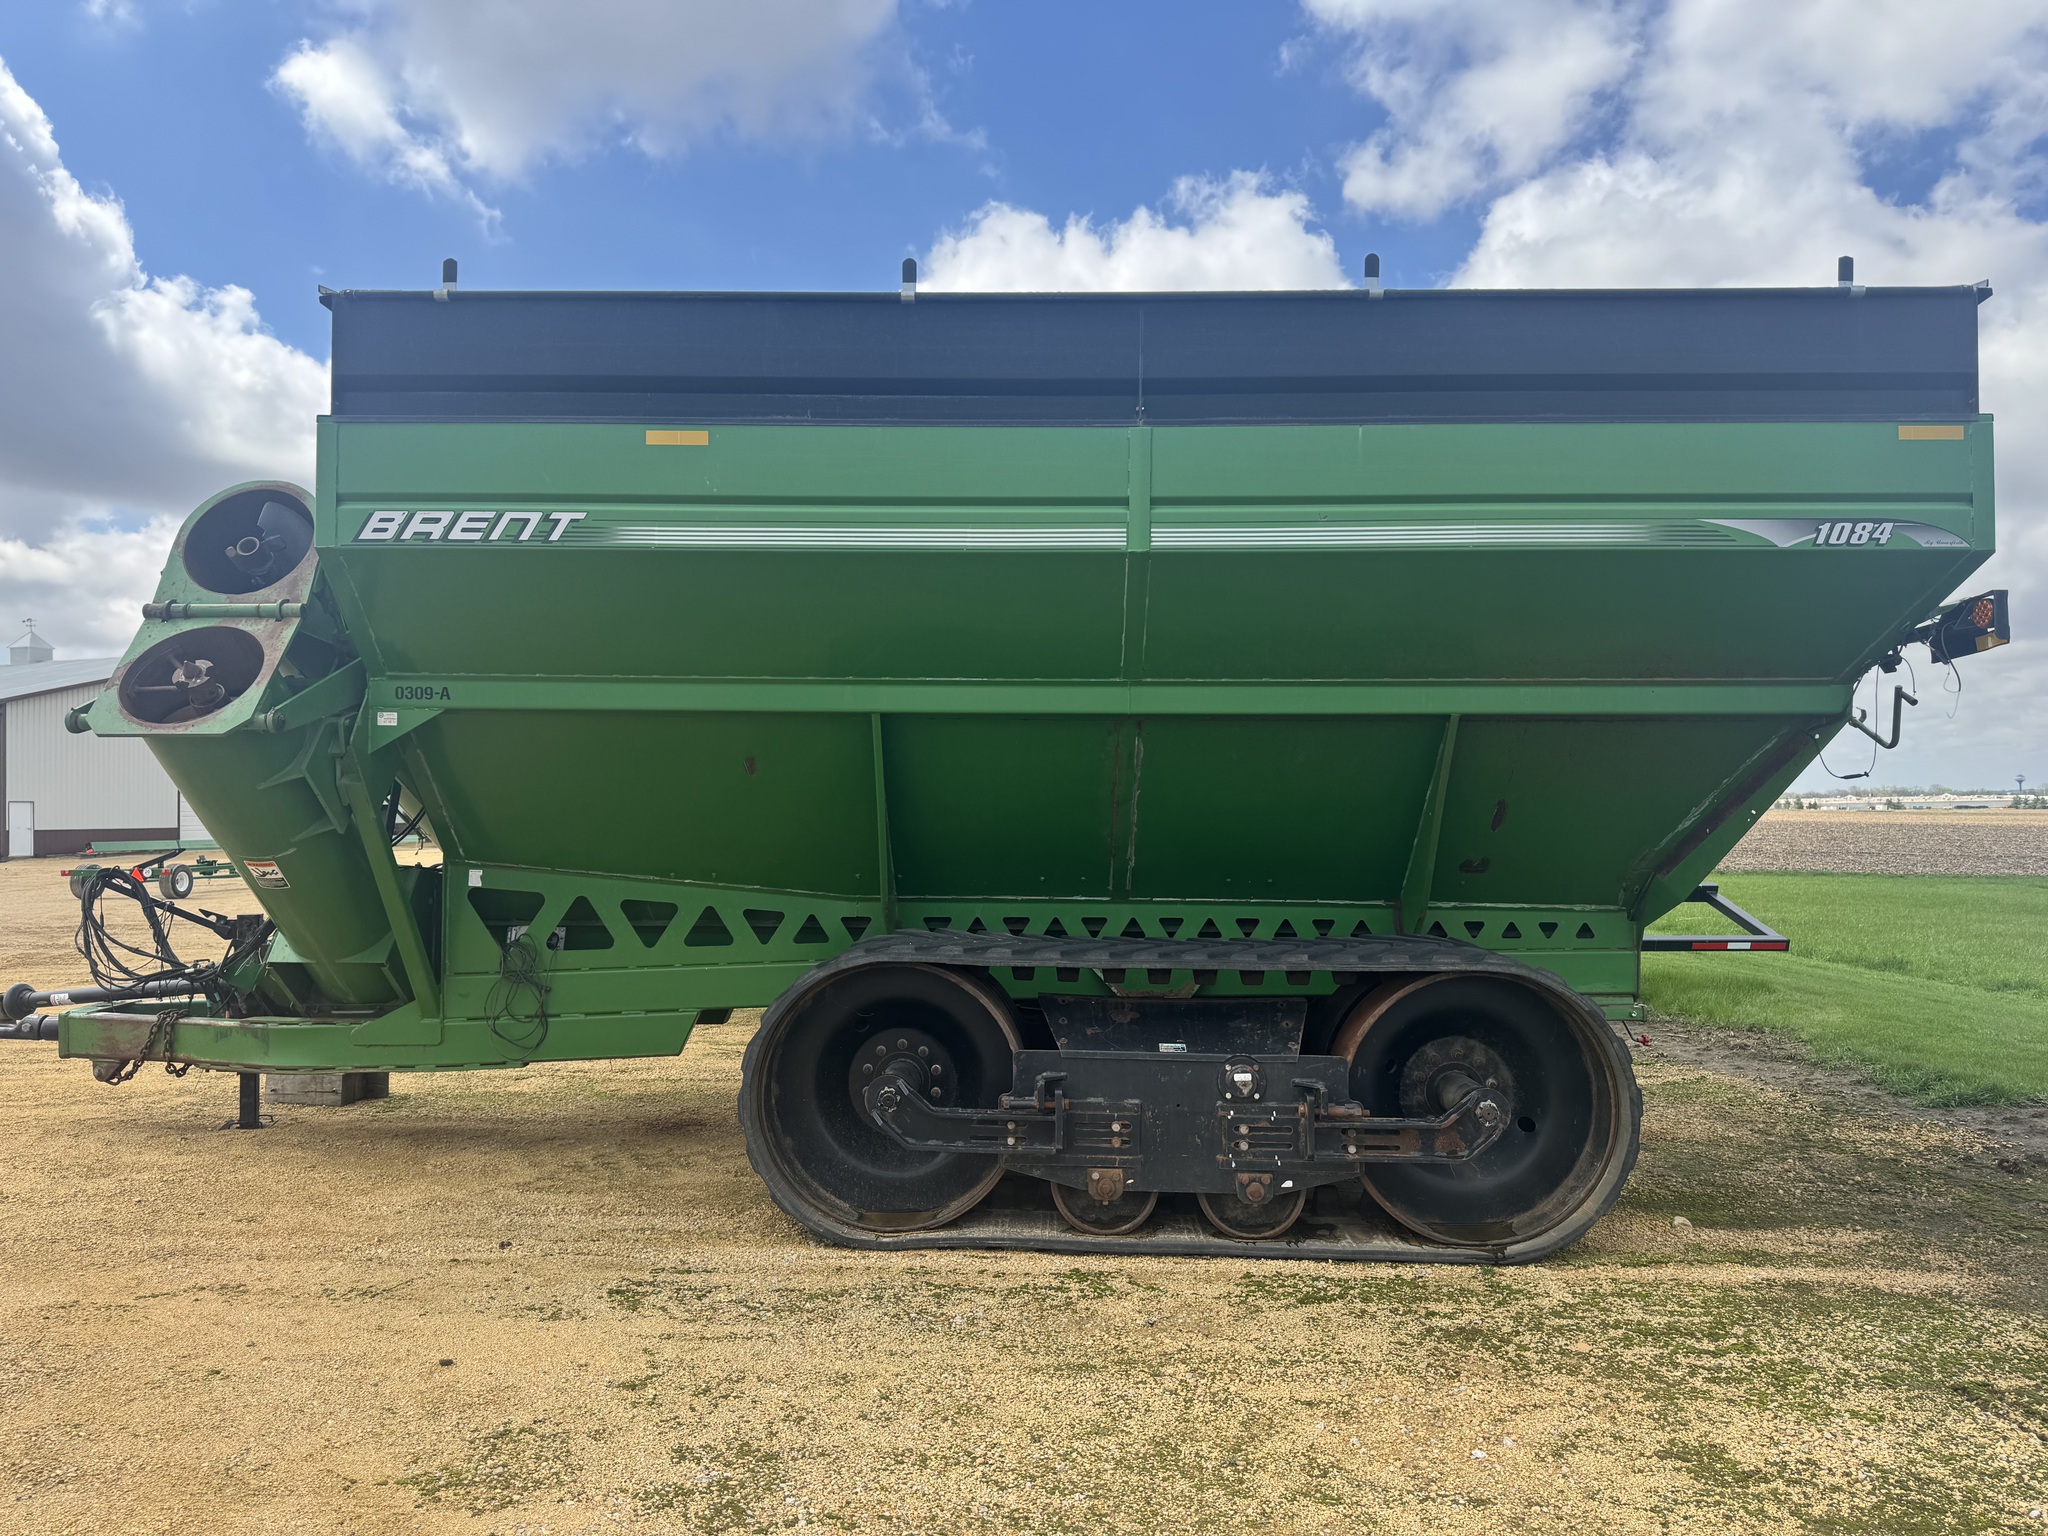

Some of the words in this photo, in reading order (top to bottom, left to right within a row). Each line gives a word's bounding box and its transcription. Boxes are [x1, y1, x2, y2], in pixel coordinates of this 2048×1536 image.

[355, 510, 588, 542] BRENT
[1815, 522, 1894, 545] 1084
[395, 686, 451, 700] 0309-A
